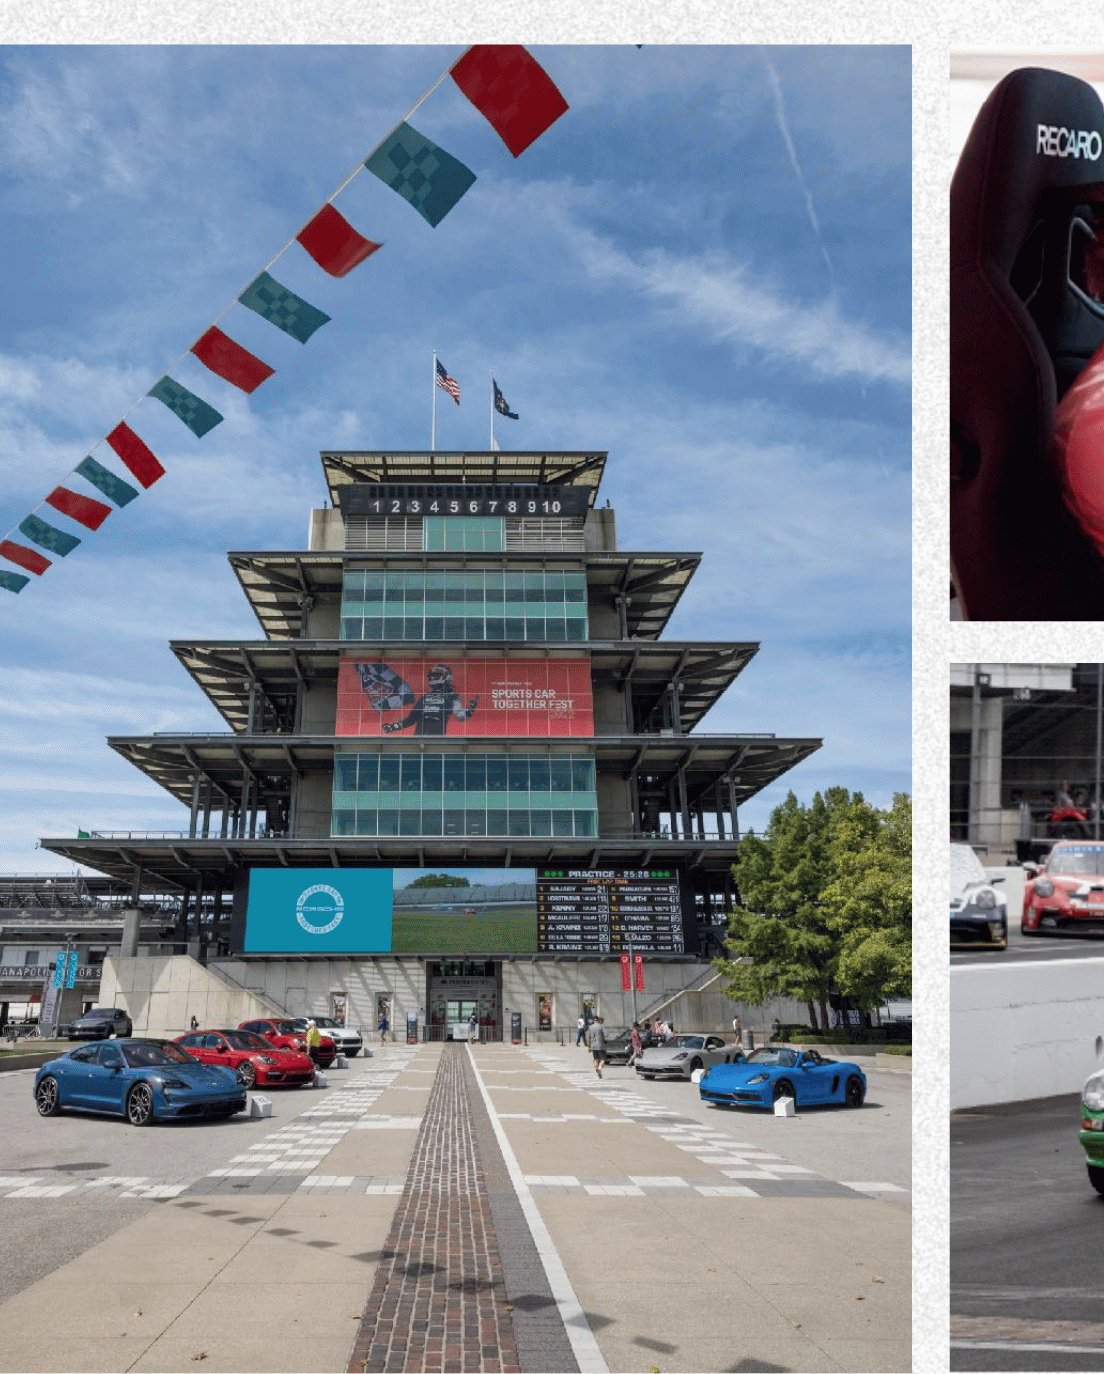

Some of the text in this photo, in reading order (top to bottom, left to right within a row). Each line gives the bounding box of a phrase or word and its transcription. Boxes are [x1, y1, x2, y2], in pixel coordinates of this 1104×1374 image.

[1036, 123, 1103, 161] RECARO
[372, 500, 561, 513] 1 2 3 4 5 6 7 8 9 10
[491, 689, 556, 698] SPORTS CAR
[492, 699, 574, 709] TOGETHER FEST
[568, 870, 615, 878] PRACTICE
[2, 967, 52, 977] ANAPOLI
